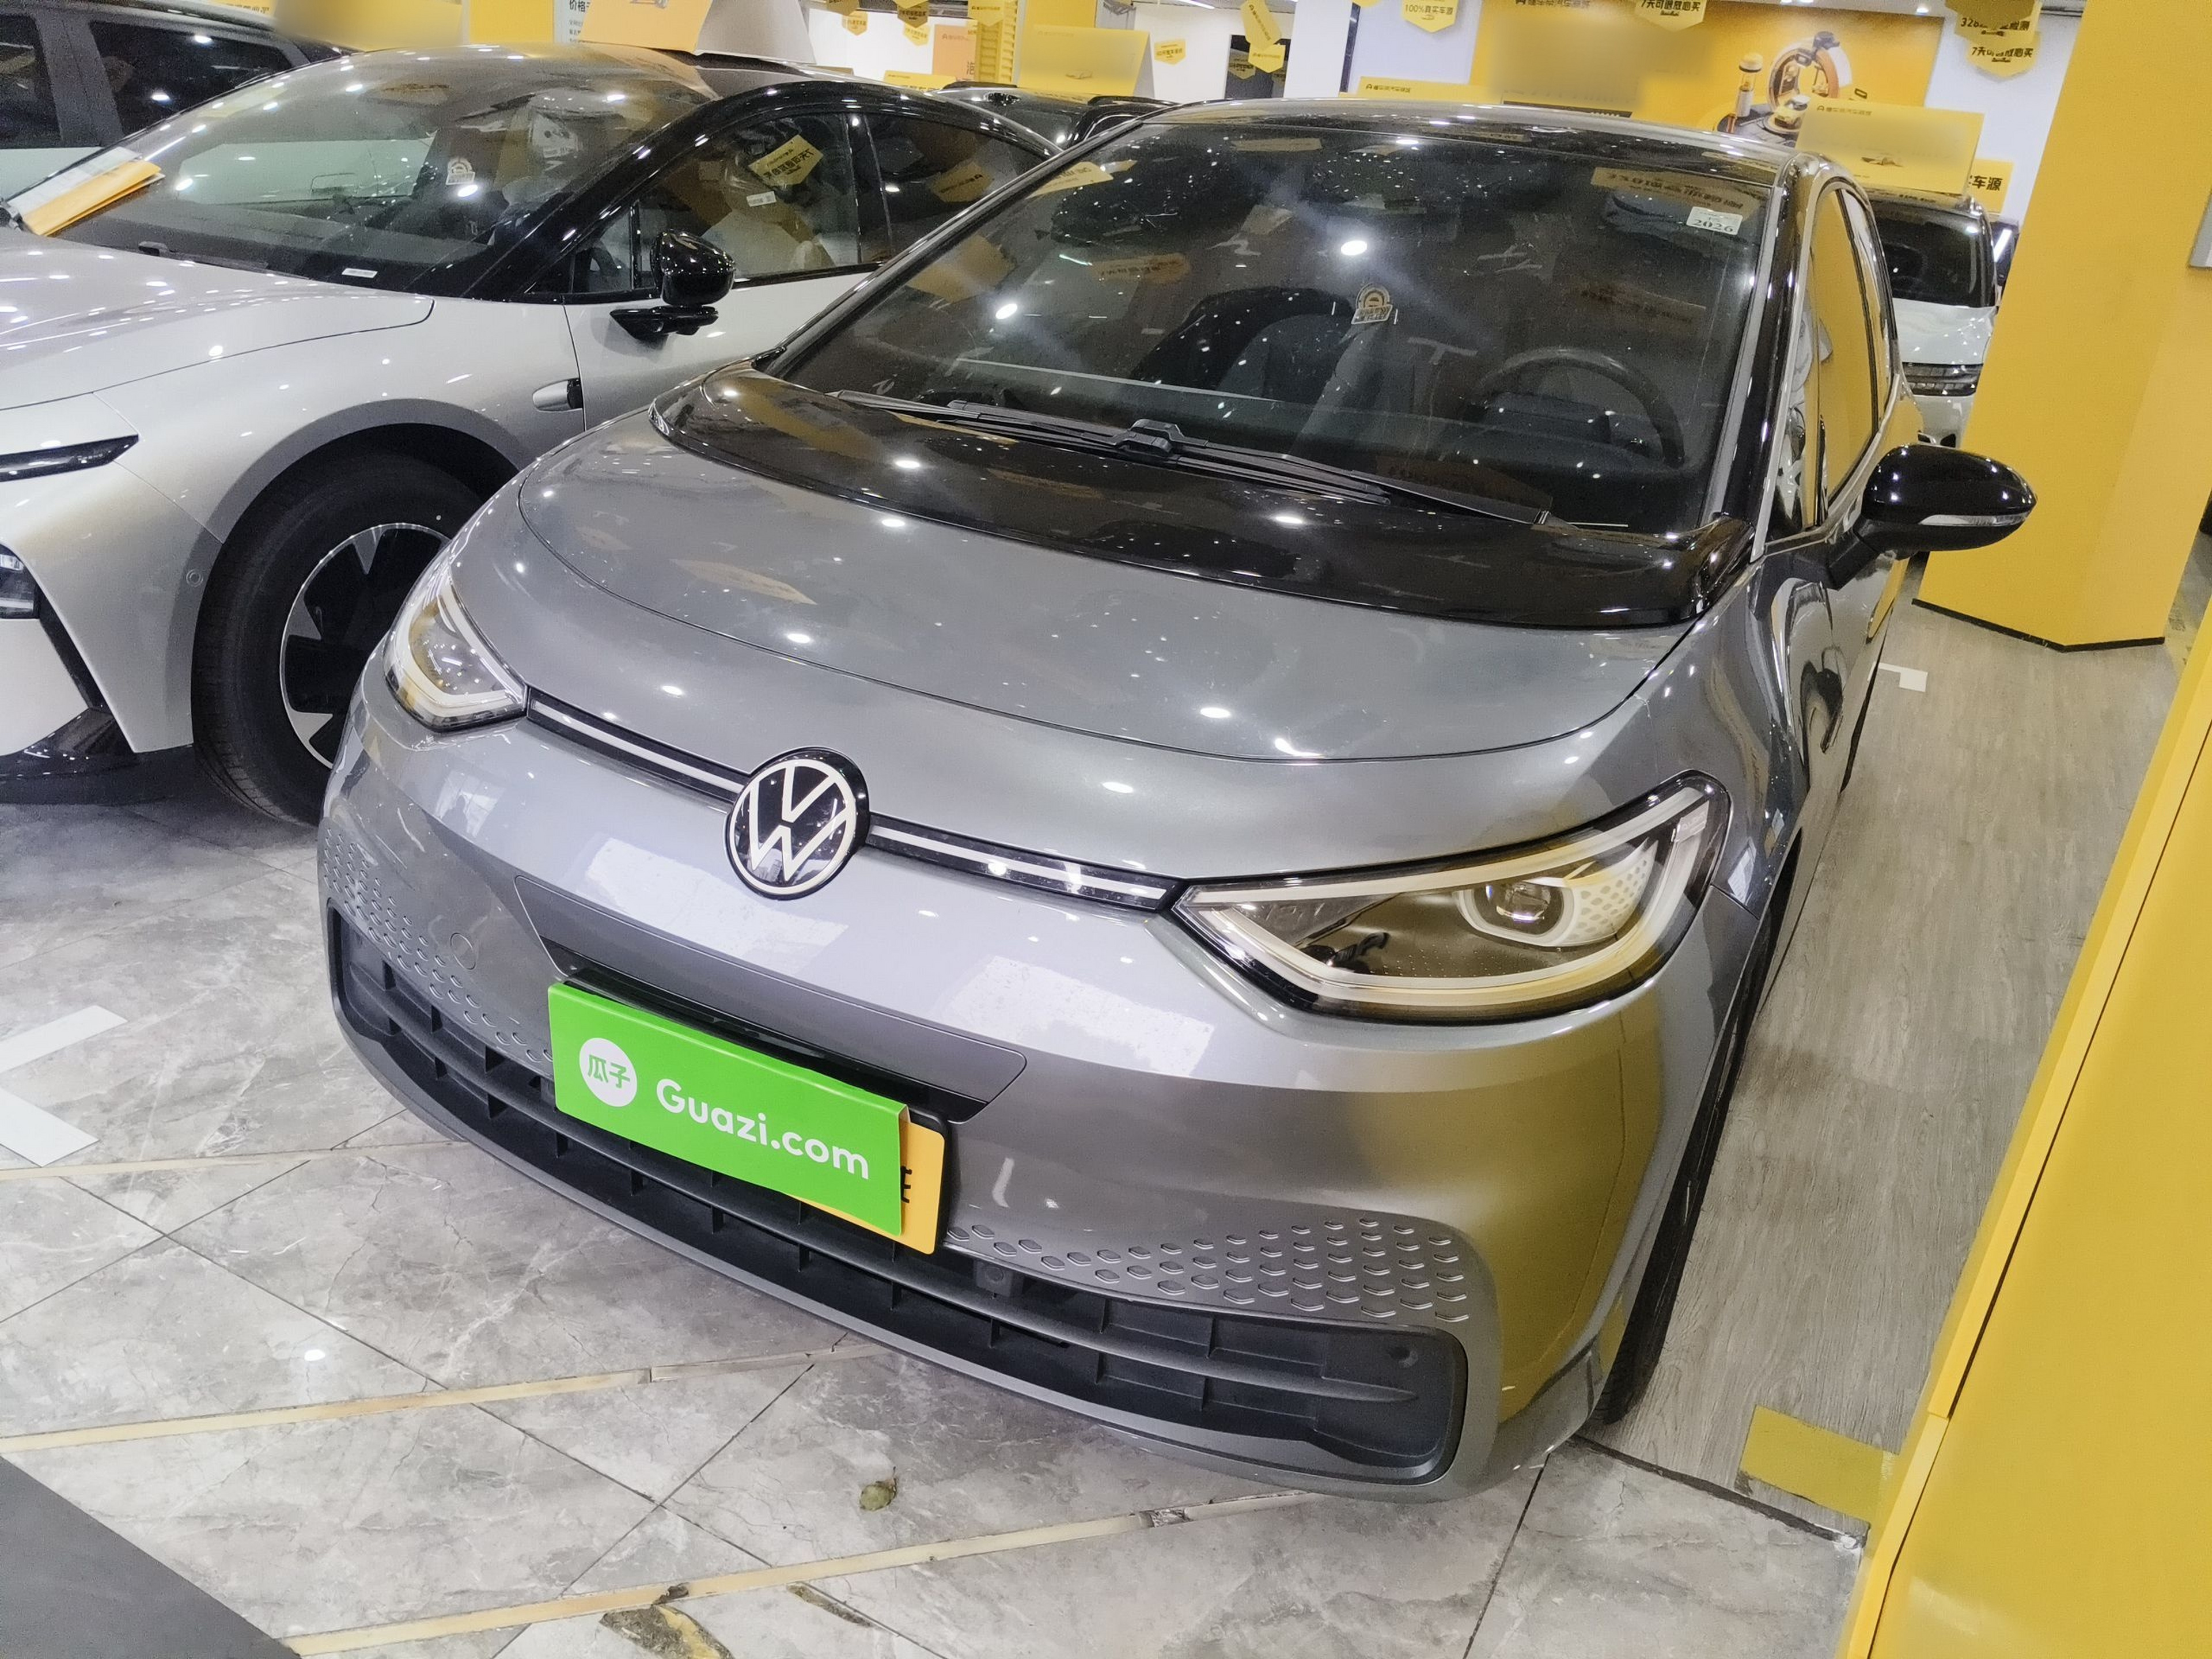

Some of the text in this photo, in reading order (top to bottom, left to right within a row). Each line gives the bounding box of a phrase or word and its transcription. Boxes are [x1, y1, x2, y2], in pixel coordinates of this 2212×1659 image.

[1969, 175, 2003, 191] 车源
[1692, 219, 1734, 232] 2026
[588, 1054, 630, 1089] 瓜子
[656, 1078, 869, 1180] Guazi.com
